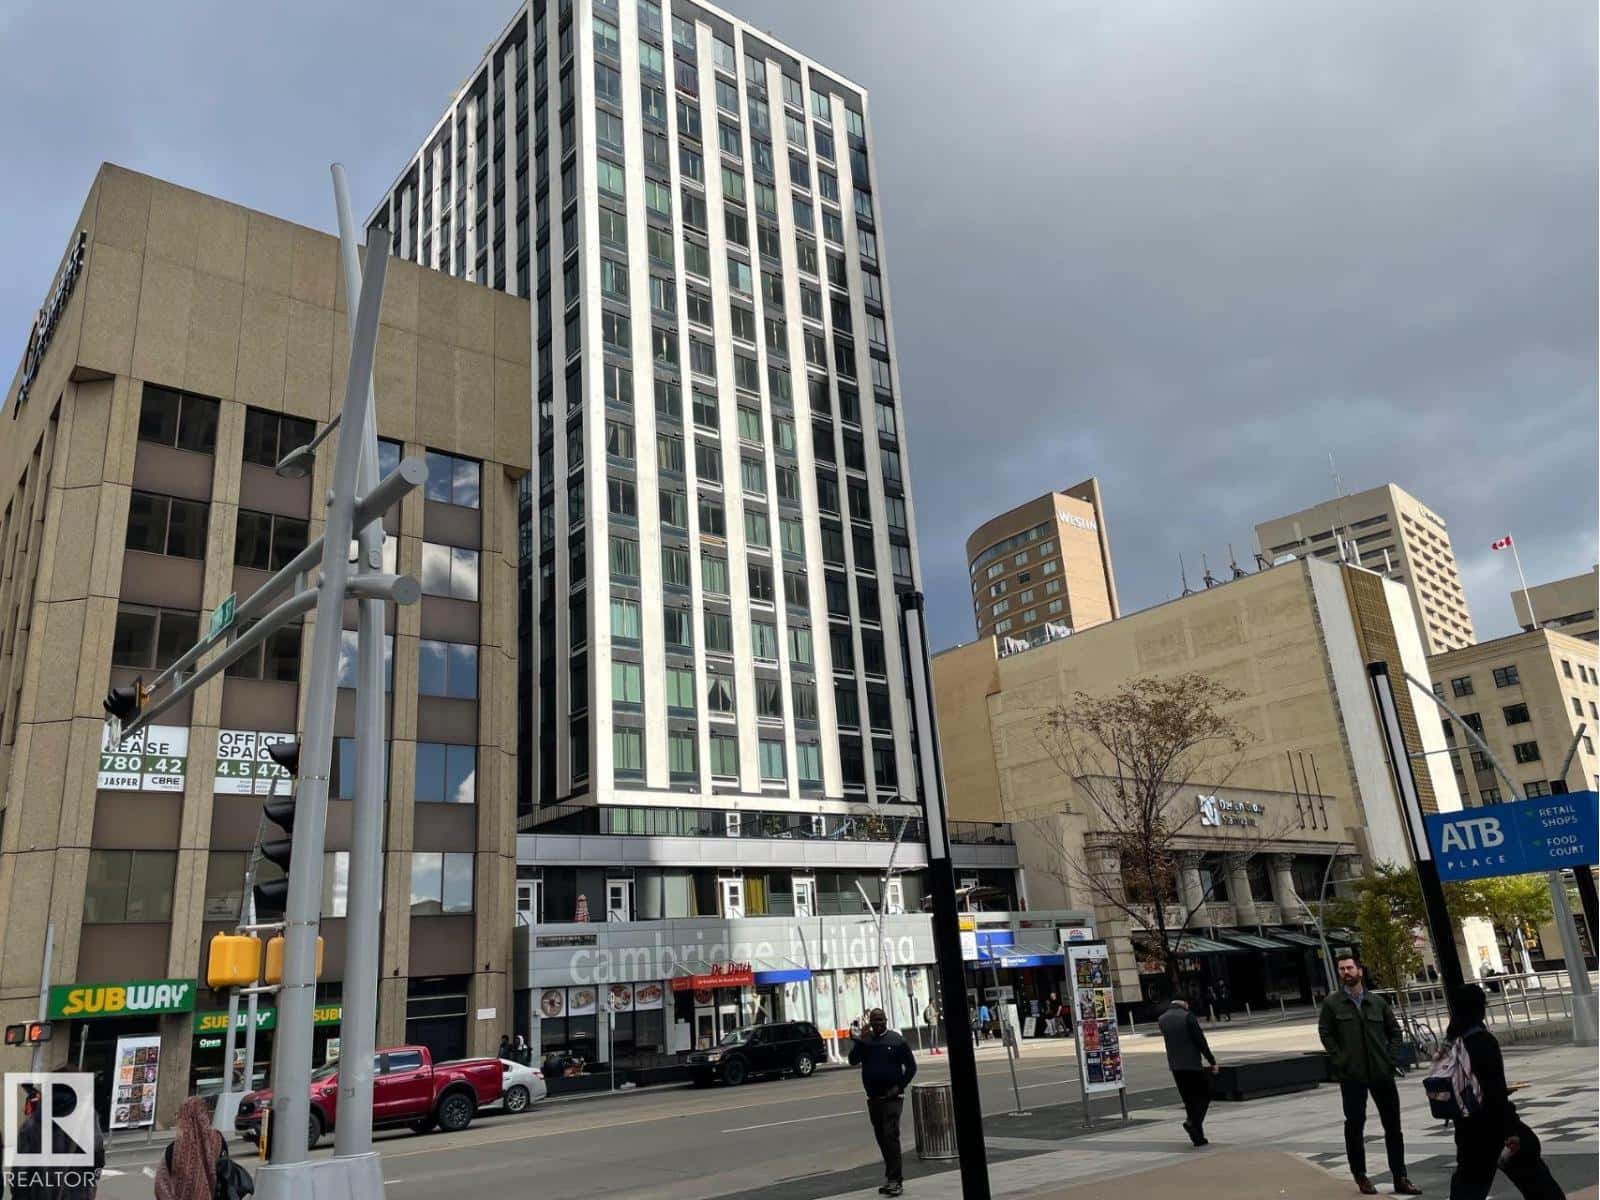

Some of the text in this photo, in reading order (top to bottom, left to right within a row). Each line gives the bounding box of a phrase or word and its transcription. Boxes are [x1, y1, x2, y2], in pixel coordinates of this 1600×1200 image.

[219, 733, 287, 747] OFFICE
[218, 745, 273, 760] SPAC
[103, 777, 138, 787] JASPER
[152, 776, 180, 785] CBRE
[1538, 804, 1576, 817] RETAIL
[1542, 815, 1578, 828] SHOPS
[1441, 816, 1505, 853] ATB
[1546, 834, 1578, 847] FOOD
[1549, 844, 1585, 857] COURT
[1447, 855, 1506, 871] PLACE
[569, 918, 915, 984] cambridge building
[63, 984, 189, 1015] SUBWAY
[199, 1011, 272, 1030] SUWY
[199, 1039, 221, 1049] Open
